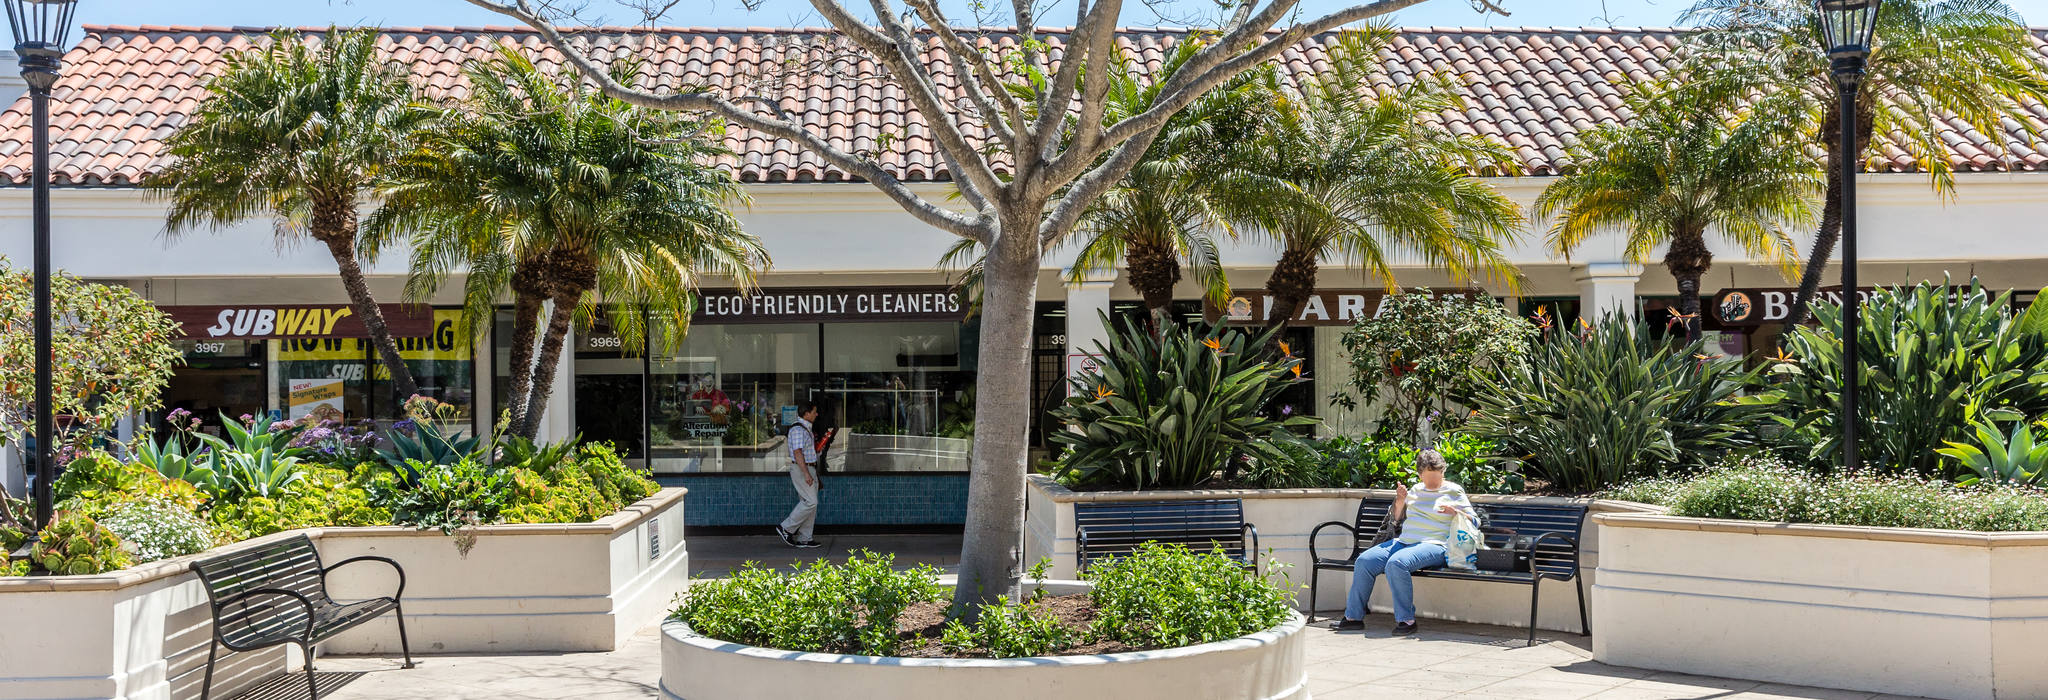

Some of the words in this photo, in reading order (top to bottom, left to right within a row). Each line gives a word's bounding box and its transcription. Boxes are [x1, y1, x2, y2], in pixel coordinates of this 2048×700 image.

[705, 296, 743, 315] ECO
[752, 294, 848, 315] FRIENDLY
[856, 293, 960, 314] CLEANERS
[207, 306, 353, 337] SUBWAY
[194, 342, 225, 353] 3967
[590, 337, 621, 348] 3969
[293, 382, 312, 391] NEW!
[292, 387, 328, 398] Signature
[312, 391, 337, 400] Wraps
[682, 422, 730, 430] Alterations
[694, 430, 728, 439] Repairs
